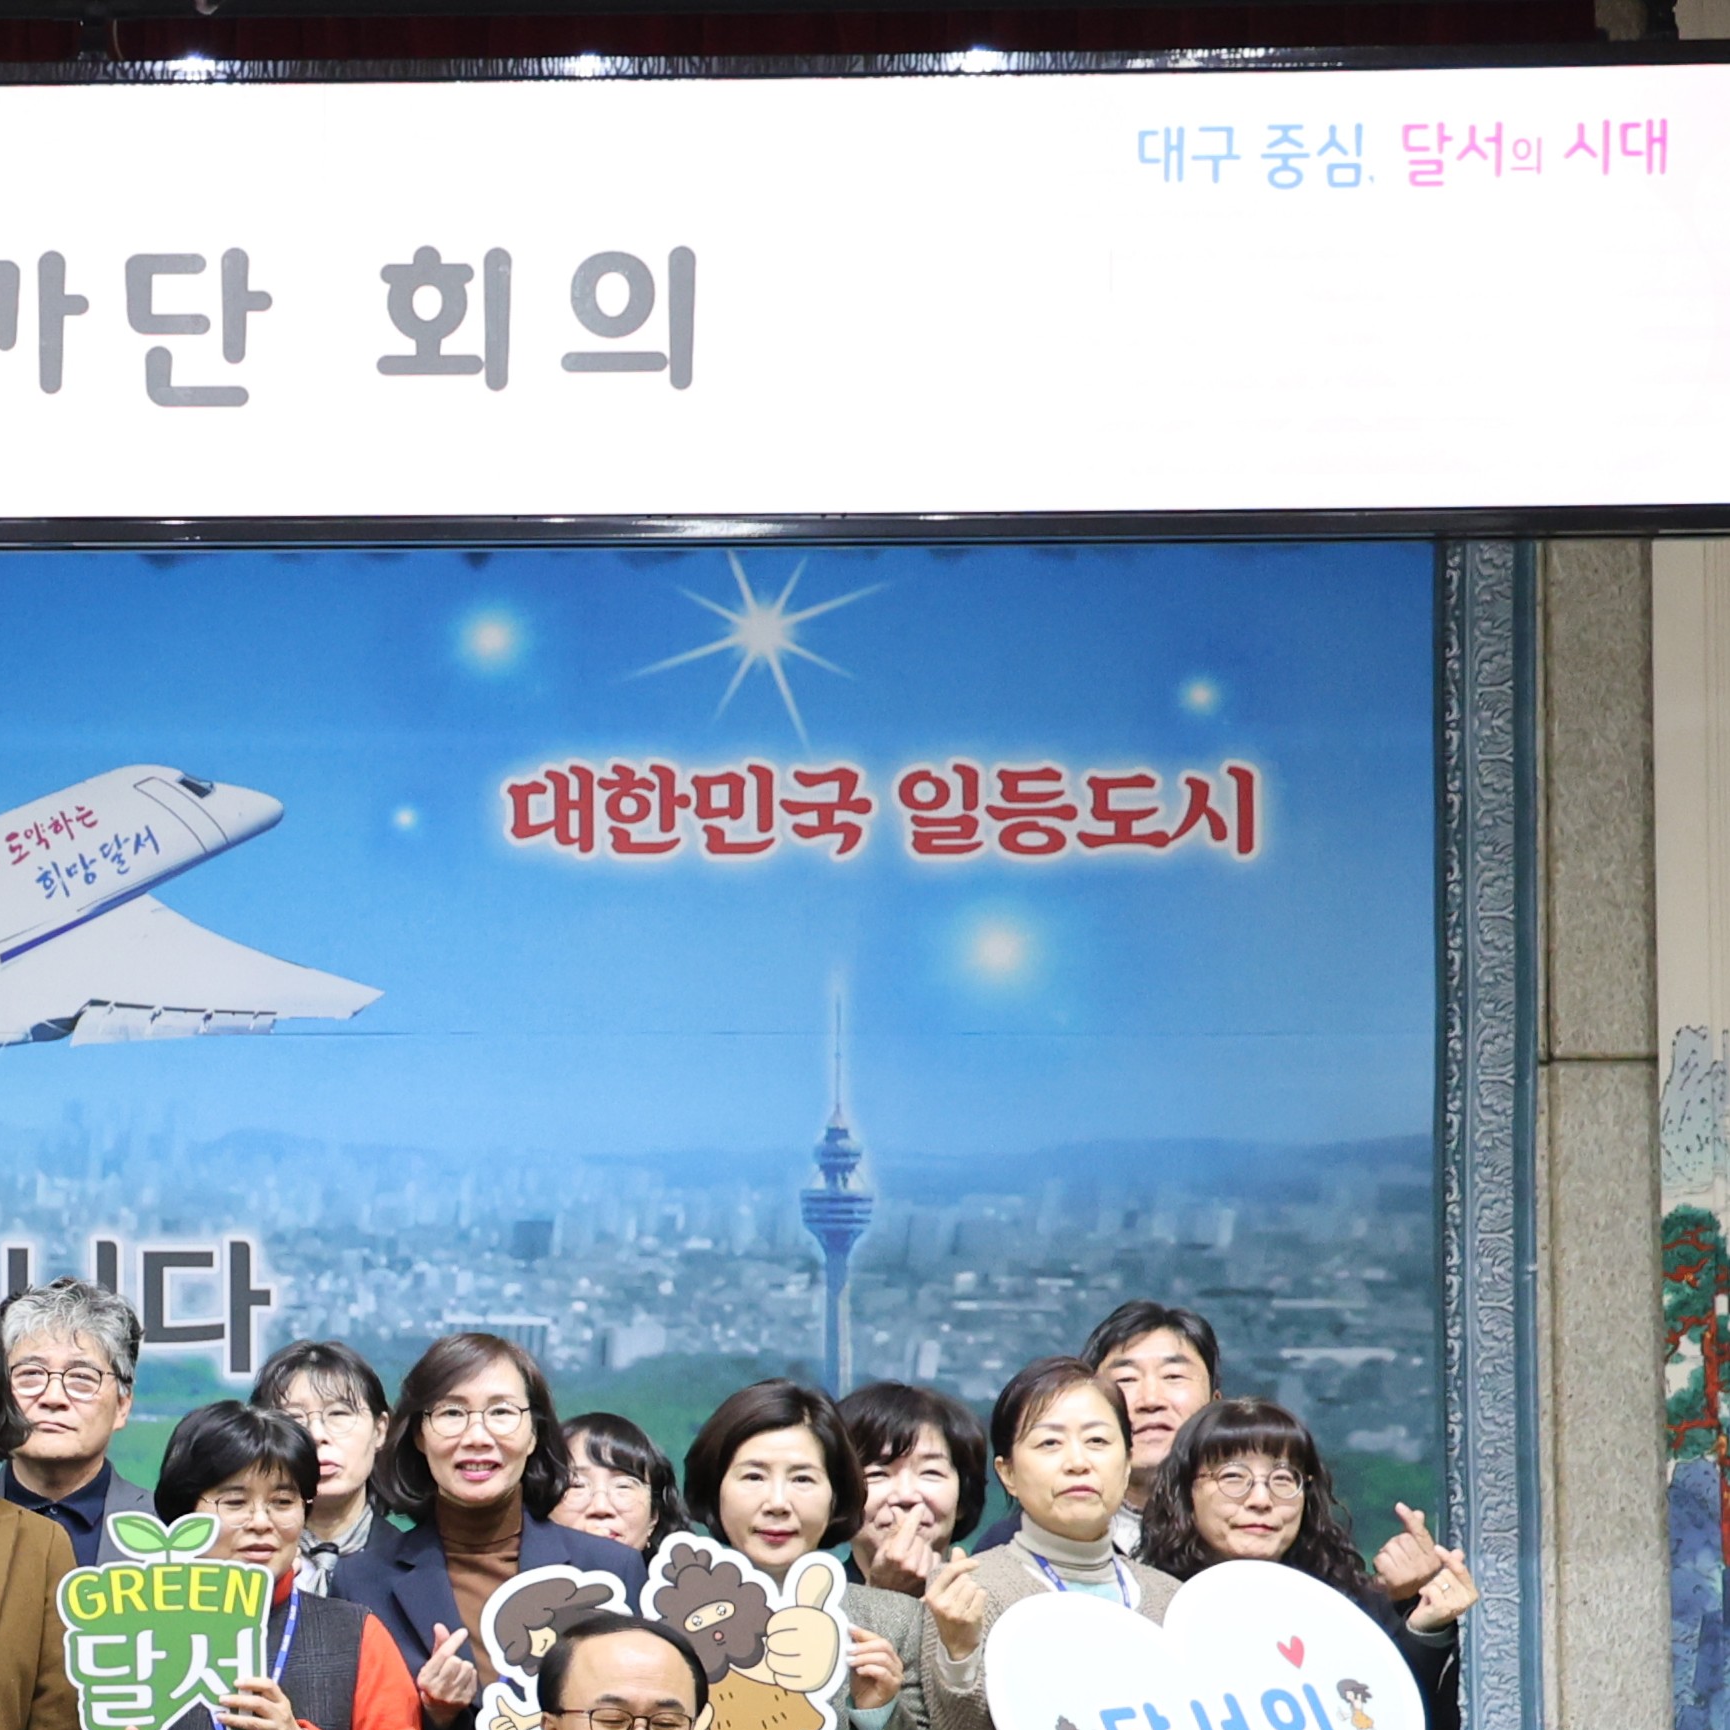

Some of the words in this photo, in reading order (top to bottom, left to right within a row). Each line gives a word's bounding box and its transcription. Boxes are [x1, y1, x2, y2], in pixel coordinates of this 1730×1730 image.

[1138, 126, 1240, 183] 대구
[1402, 121, 1542, 187] 달서의
[1564, 118, 1668, 175] 시대
[376, 245, 697, 392] 회의
[5, 806, 98, 865] 도약하는
[508, 764, 872, 855] 대한민국
[898, 764, 1256, 855] 일등도시
[67, 1566, 262, 1620] GREEN
[77, 1627, 253, 1728] 달서
